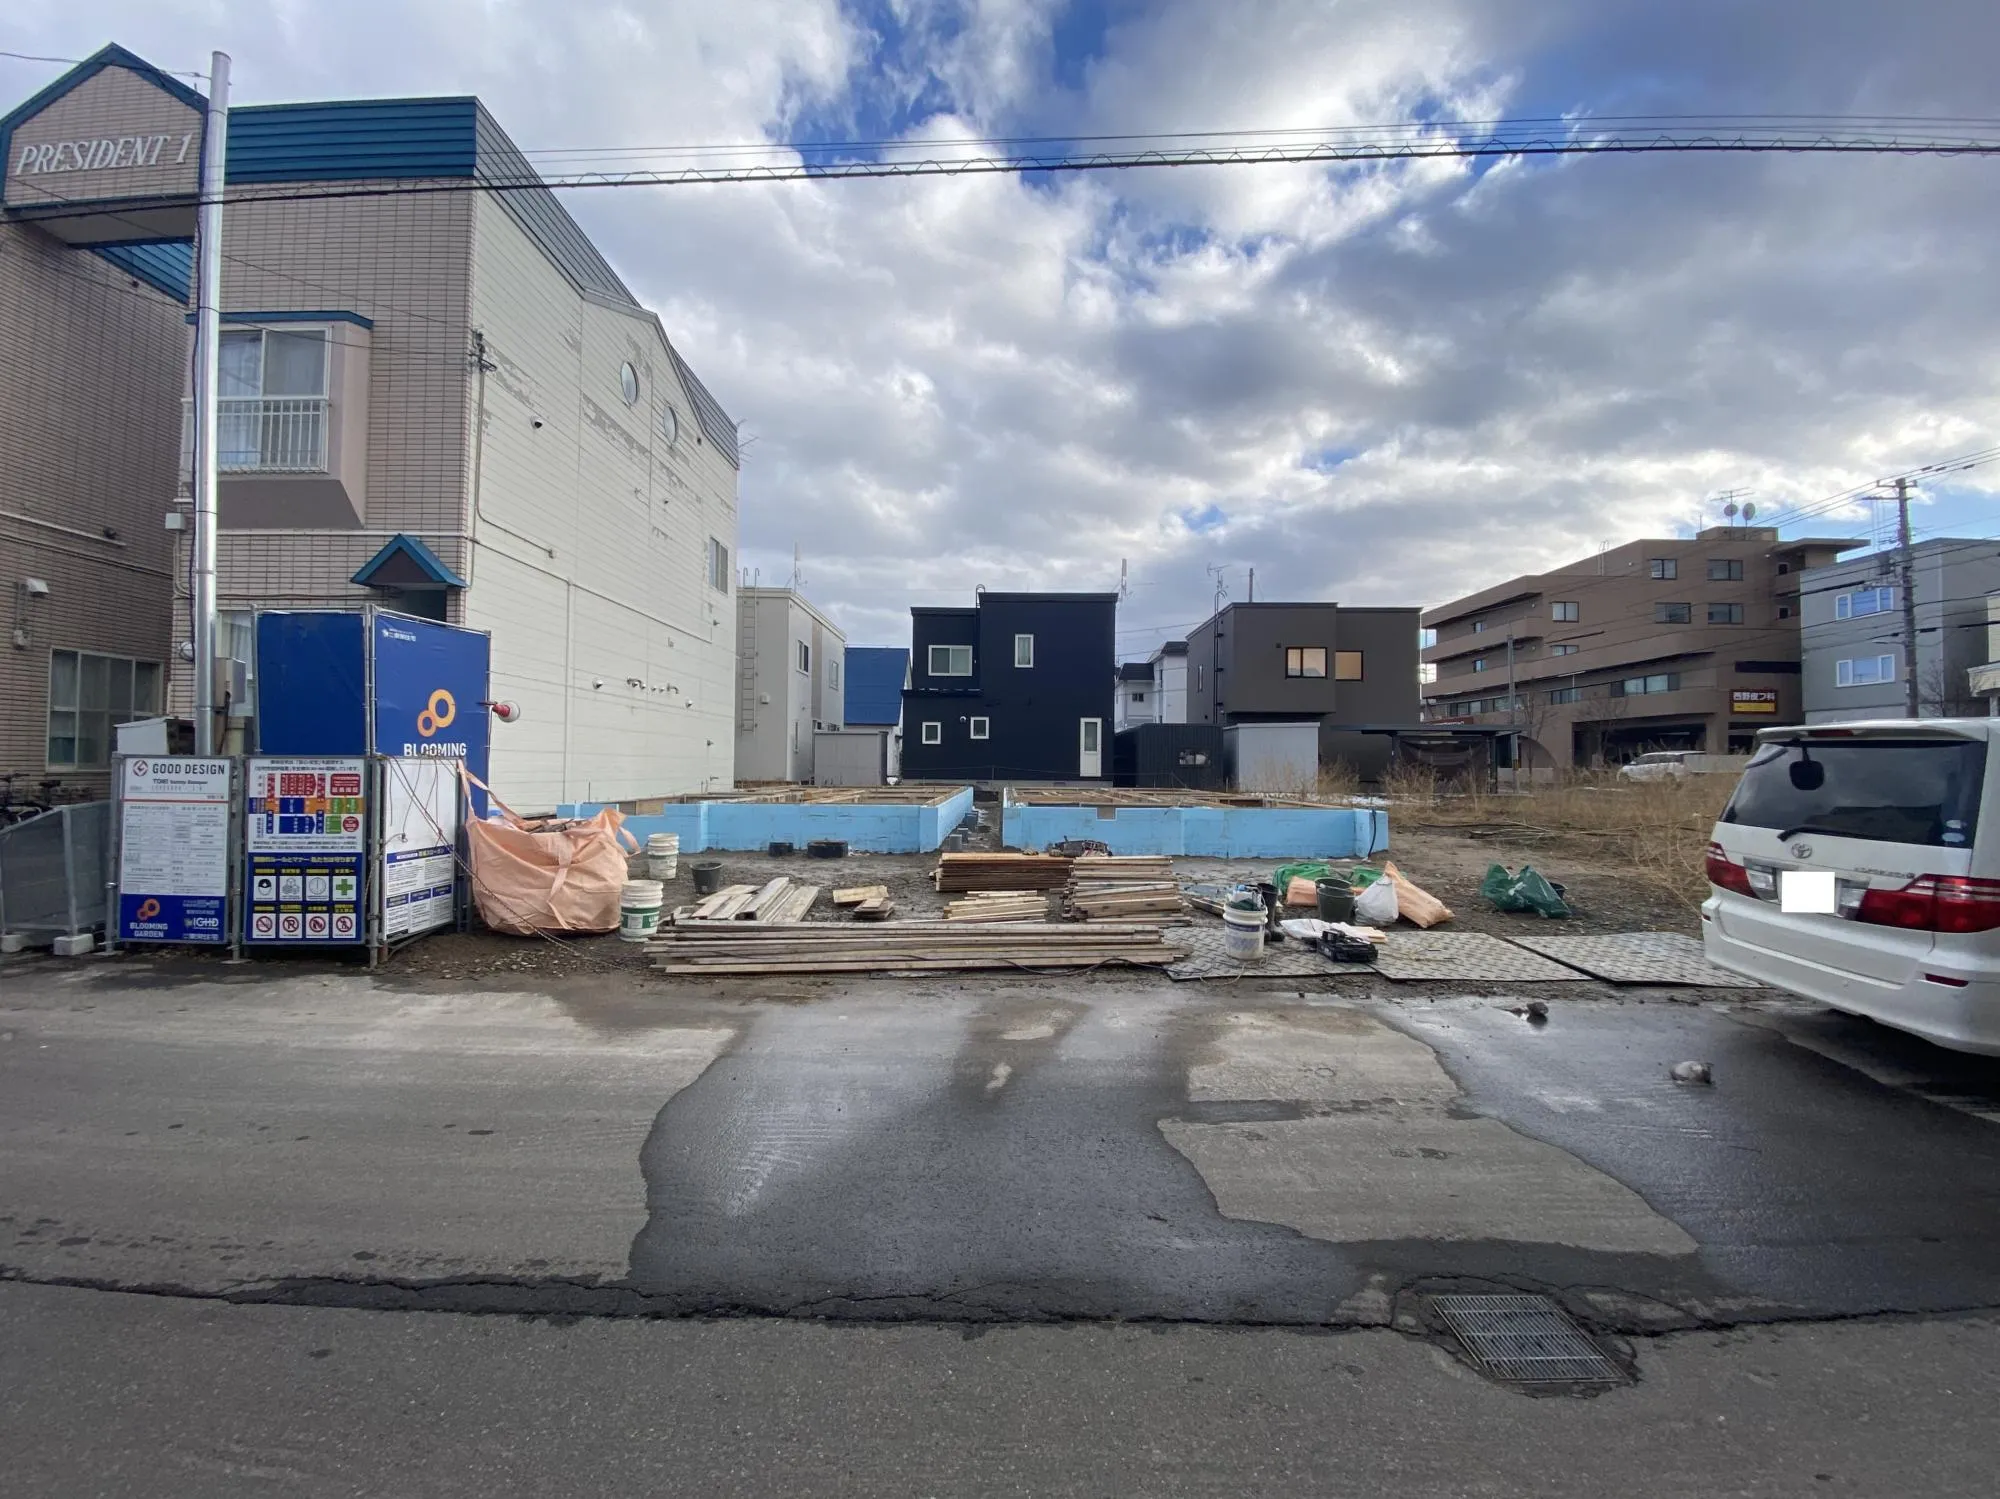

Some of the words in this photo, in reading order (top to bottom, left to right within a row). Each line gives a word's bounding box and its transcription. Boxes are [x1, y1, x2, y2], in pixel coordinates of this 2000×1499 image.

[15, 135, 171, 176] PRESIDENT
[175, 132, 193, 165] 1
[403, 742, 467, 757] BLOOMING
[152, 763, 182, 775] GOOD
[184, 763, 225, 775] DESIGN
[129, 922, 168, 930] BLOOMING
[134, 930, 164, 938] GARDEN
